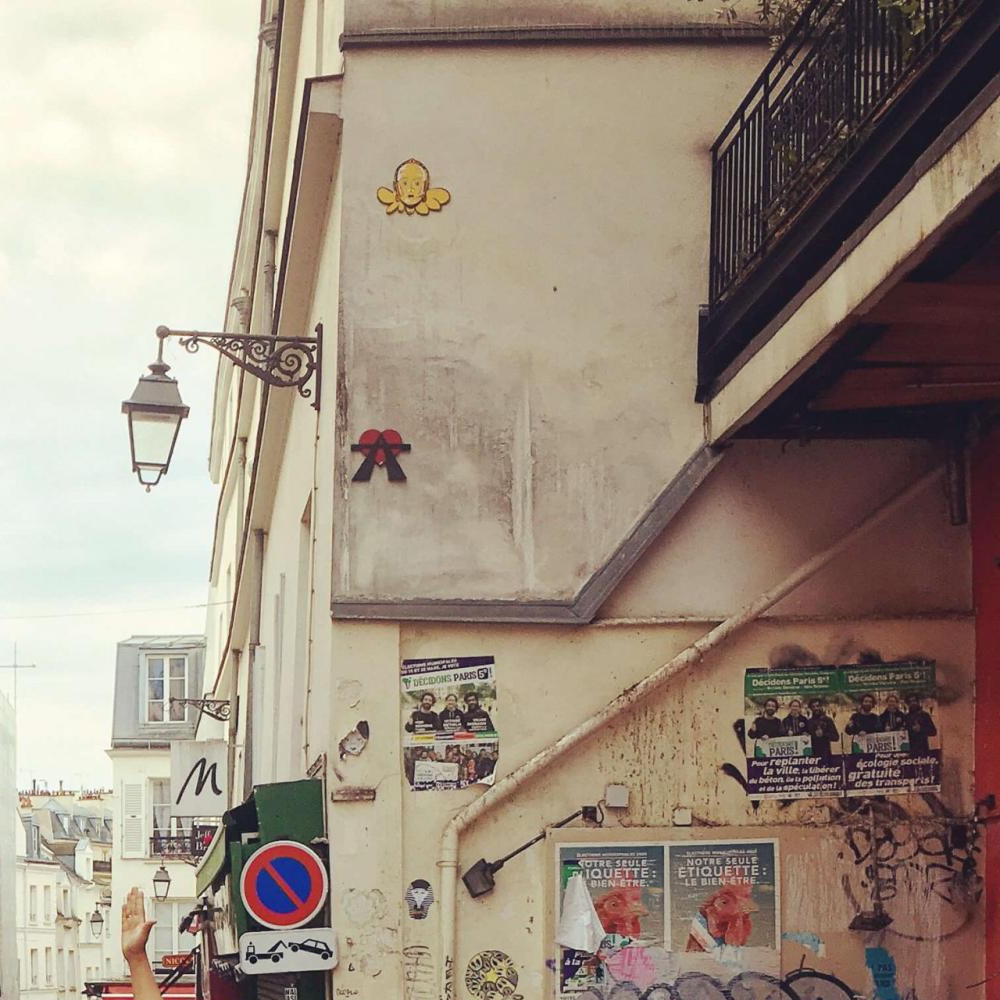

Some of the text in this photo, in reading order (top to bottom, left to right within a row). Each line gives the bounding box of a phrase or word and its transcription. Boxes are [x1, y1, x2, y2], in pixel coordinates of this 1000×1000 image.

[454, 670, 477, 681] PARIS
[792, 676, 816, 685] Paris
[888, 671, 912, 681] Paris
[769, 757, 822, 767] replanter
[856, 758, 899, 769] écologie
[763, 766, 774, 775] la
[809, 765, 841, 774] libérer
[848, 768, 901, 782] gratuité
[855, 779, 873, 788] des
[615, 859, 648, 868] SEULE
[686, 856, 759, 867] NOTRE SEULE
[685, 877, 697, 887] LE
